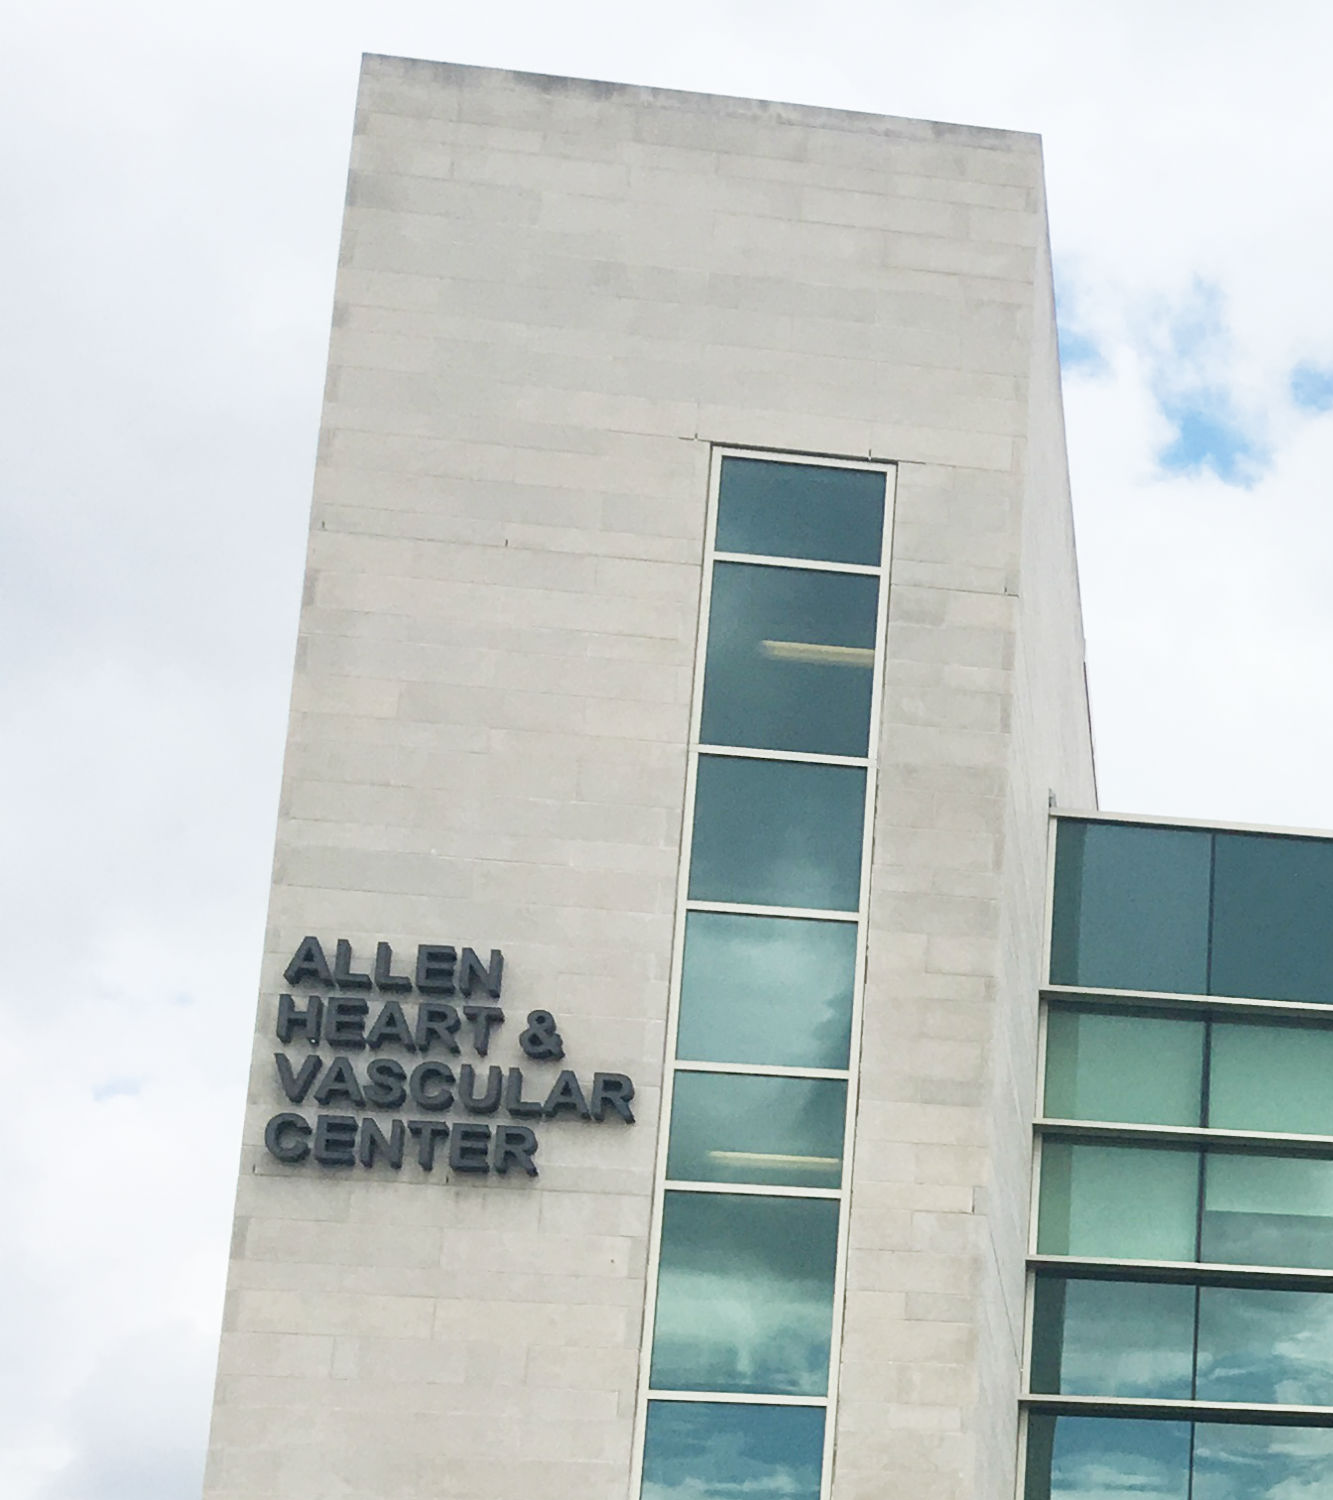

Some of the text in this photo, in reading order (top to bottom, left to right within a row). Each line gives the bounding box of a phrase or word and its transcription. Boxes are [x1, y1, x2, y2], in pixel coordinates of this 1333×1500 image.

[283, 936, 504, 998] ALLEN
[275, 993, 565, 1060] HEART &
[274, 1052, 636, 1124] VASCULAR
[264, 1112, 539, 1177] CENTER
